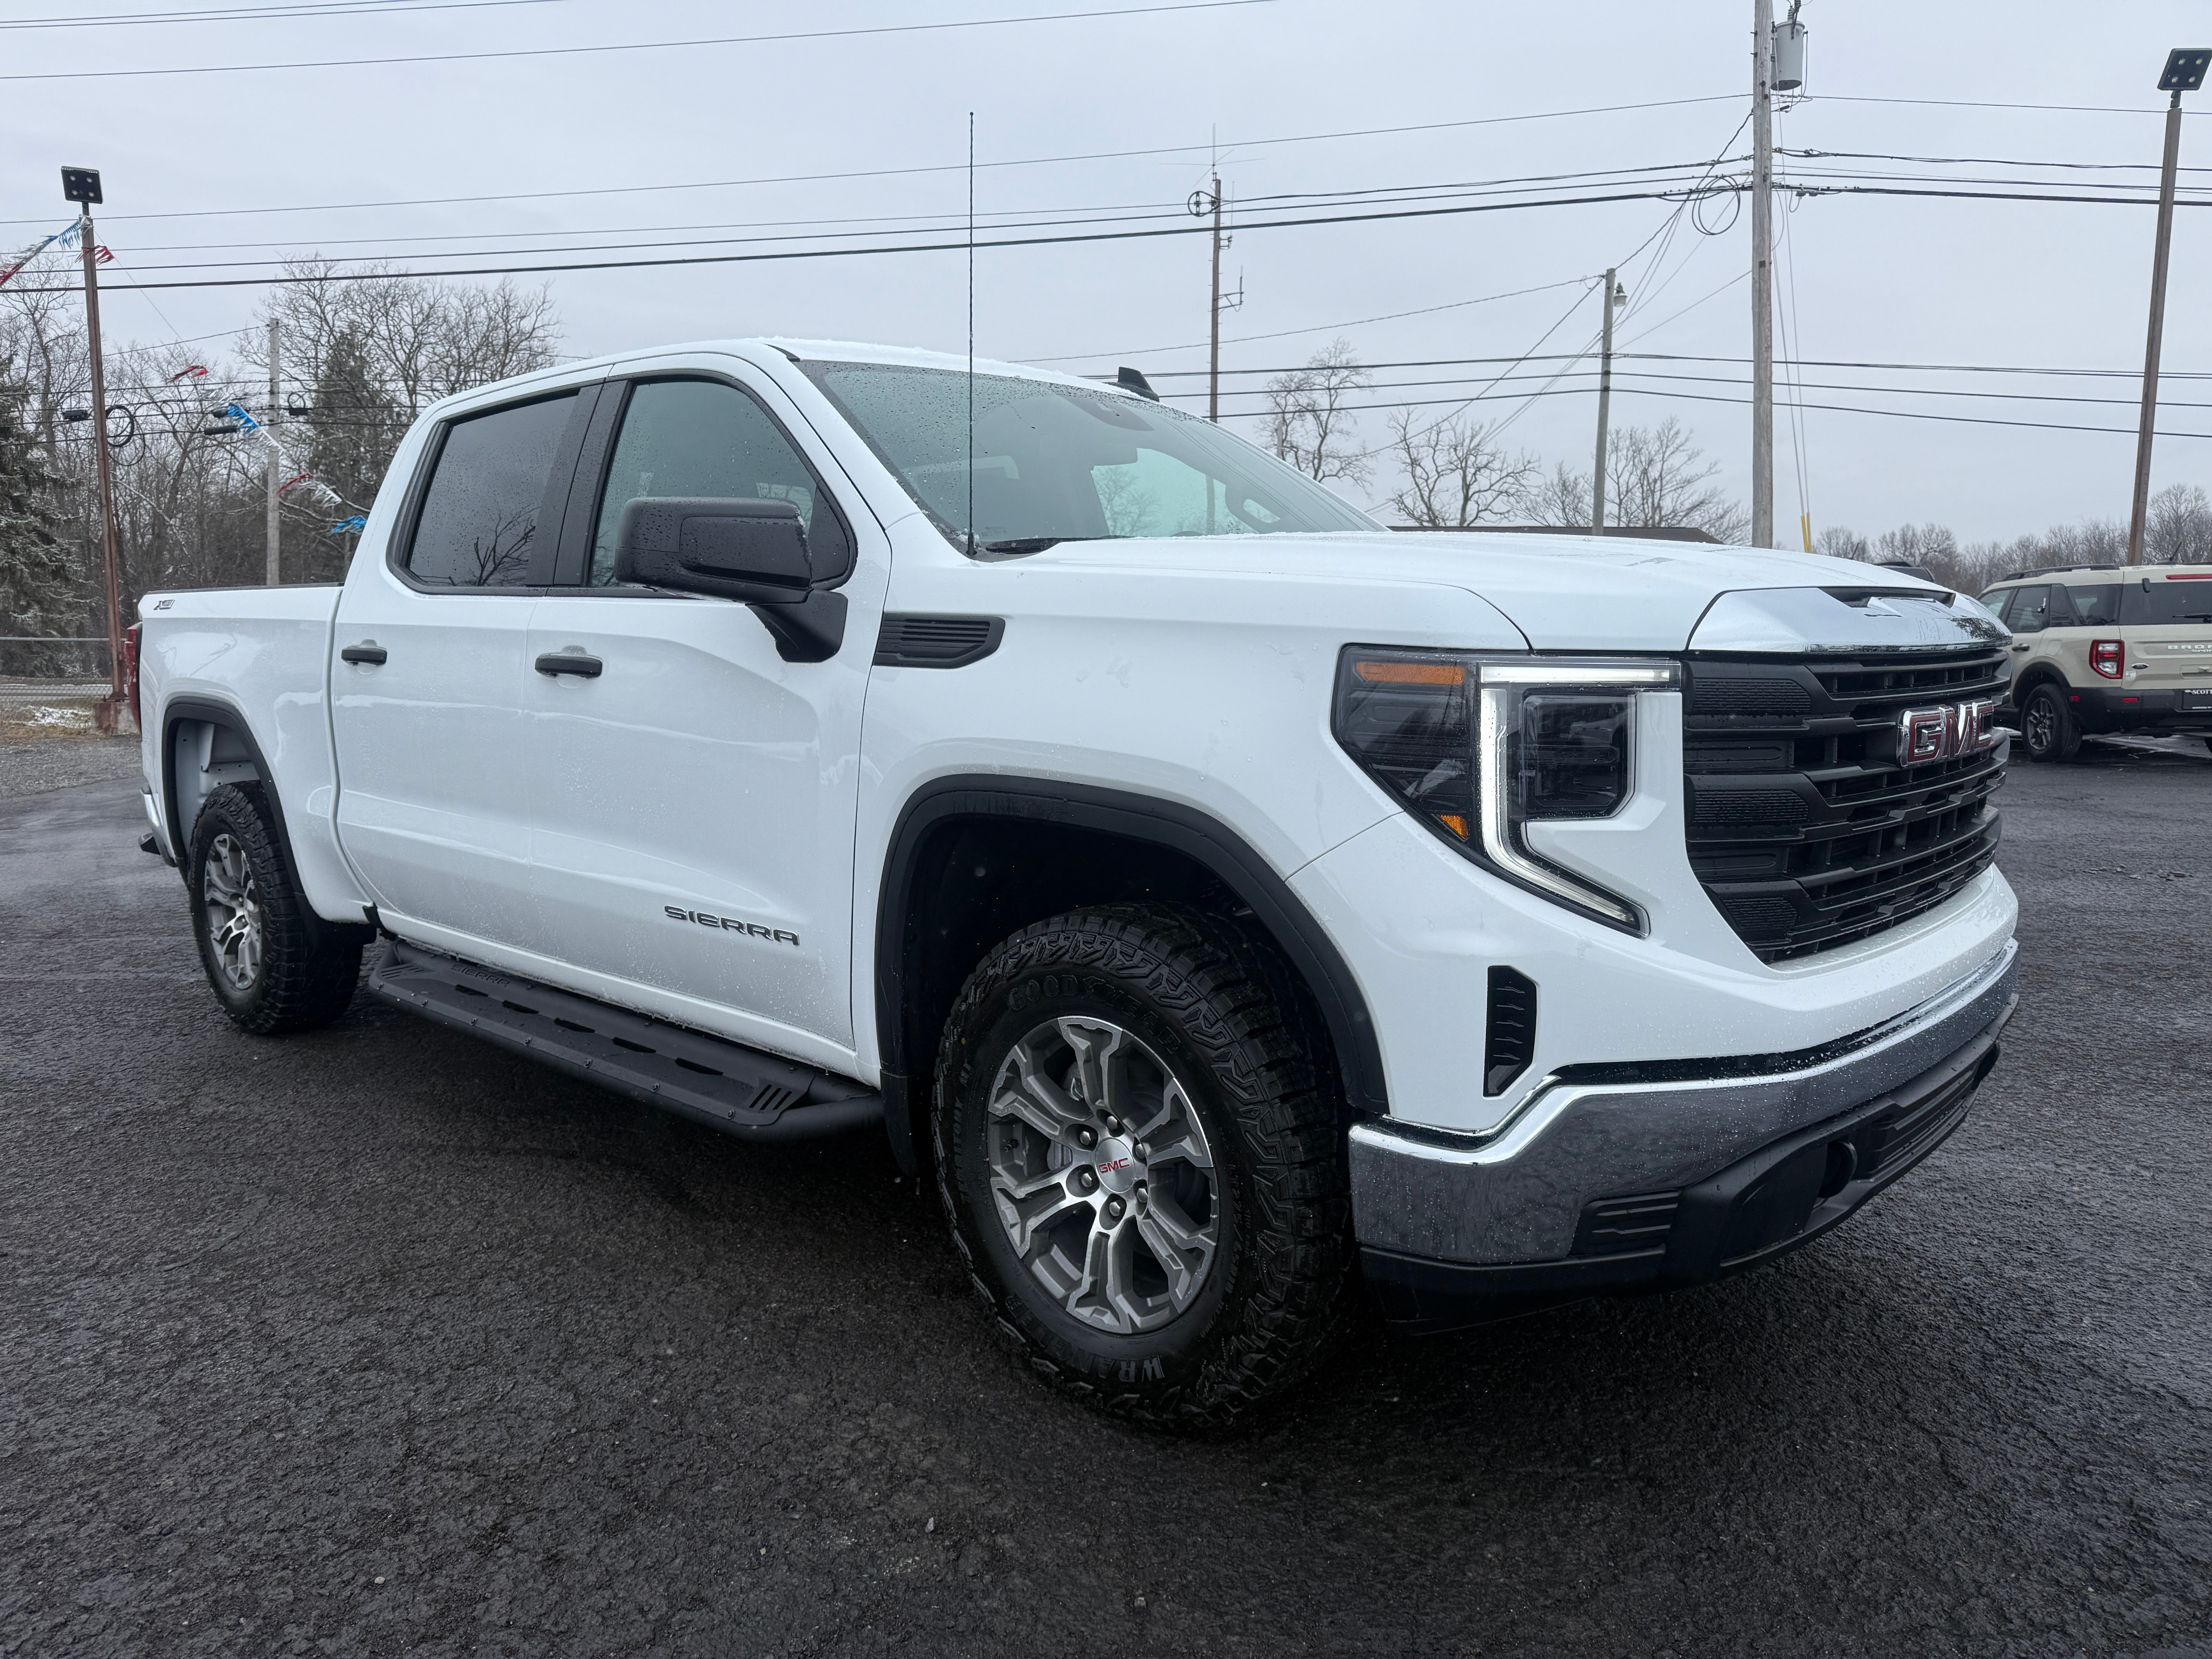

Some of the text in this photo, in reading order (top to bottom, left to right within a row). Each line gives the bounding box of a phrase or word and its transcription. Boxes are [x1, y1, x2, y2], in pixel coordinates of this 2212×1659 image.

[1901, 701, 1994, 767] GMC
[664, 905, 800, 946] SIERRA
[451, 964, 510, 987] SIERRA
[1099, 1158, 1131, 1174] GMC
[1006, 1291, 1165, 1382] WRANGLER
